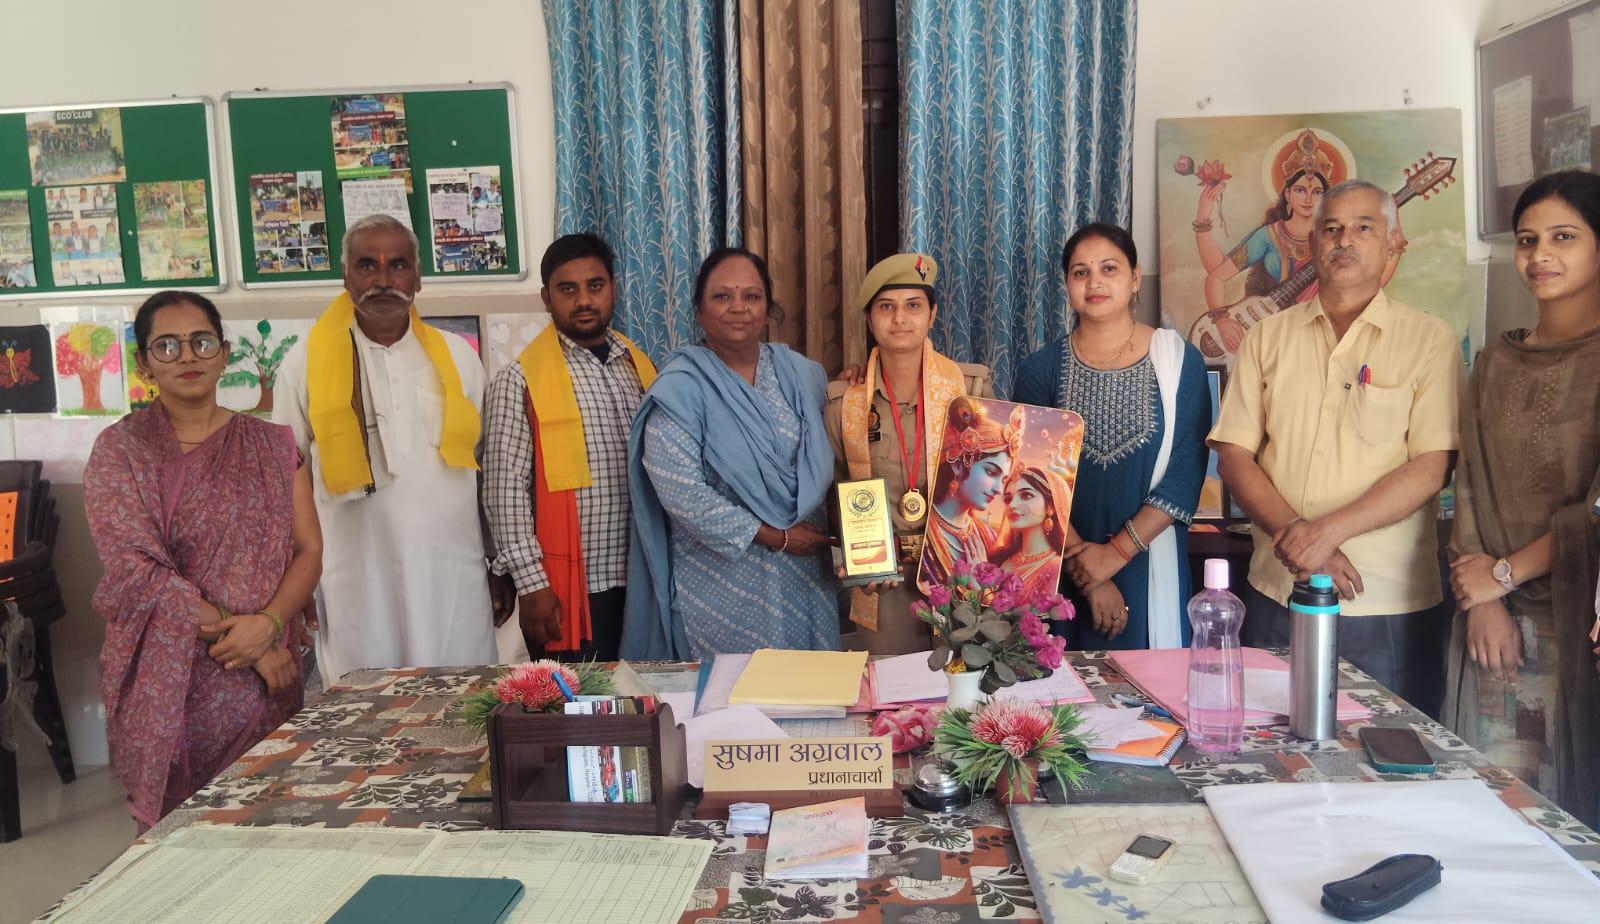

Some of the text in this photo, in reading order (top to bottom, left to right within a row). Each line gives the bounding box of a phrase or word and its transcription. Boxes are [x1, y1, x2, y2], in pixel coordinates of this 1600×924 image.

[56, 111, 92, 121] ECO CLUB
[711, 742, 884, 770] सुषमा अग्रवाल
[807, 765, 884, 785] प्रधानाचार्या
